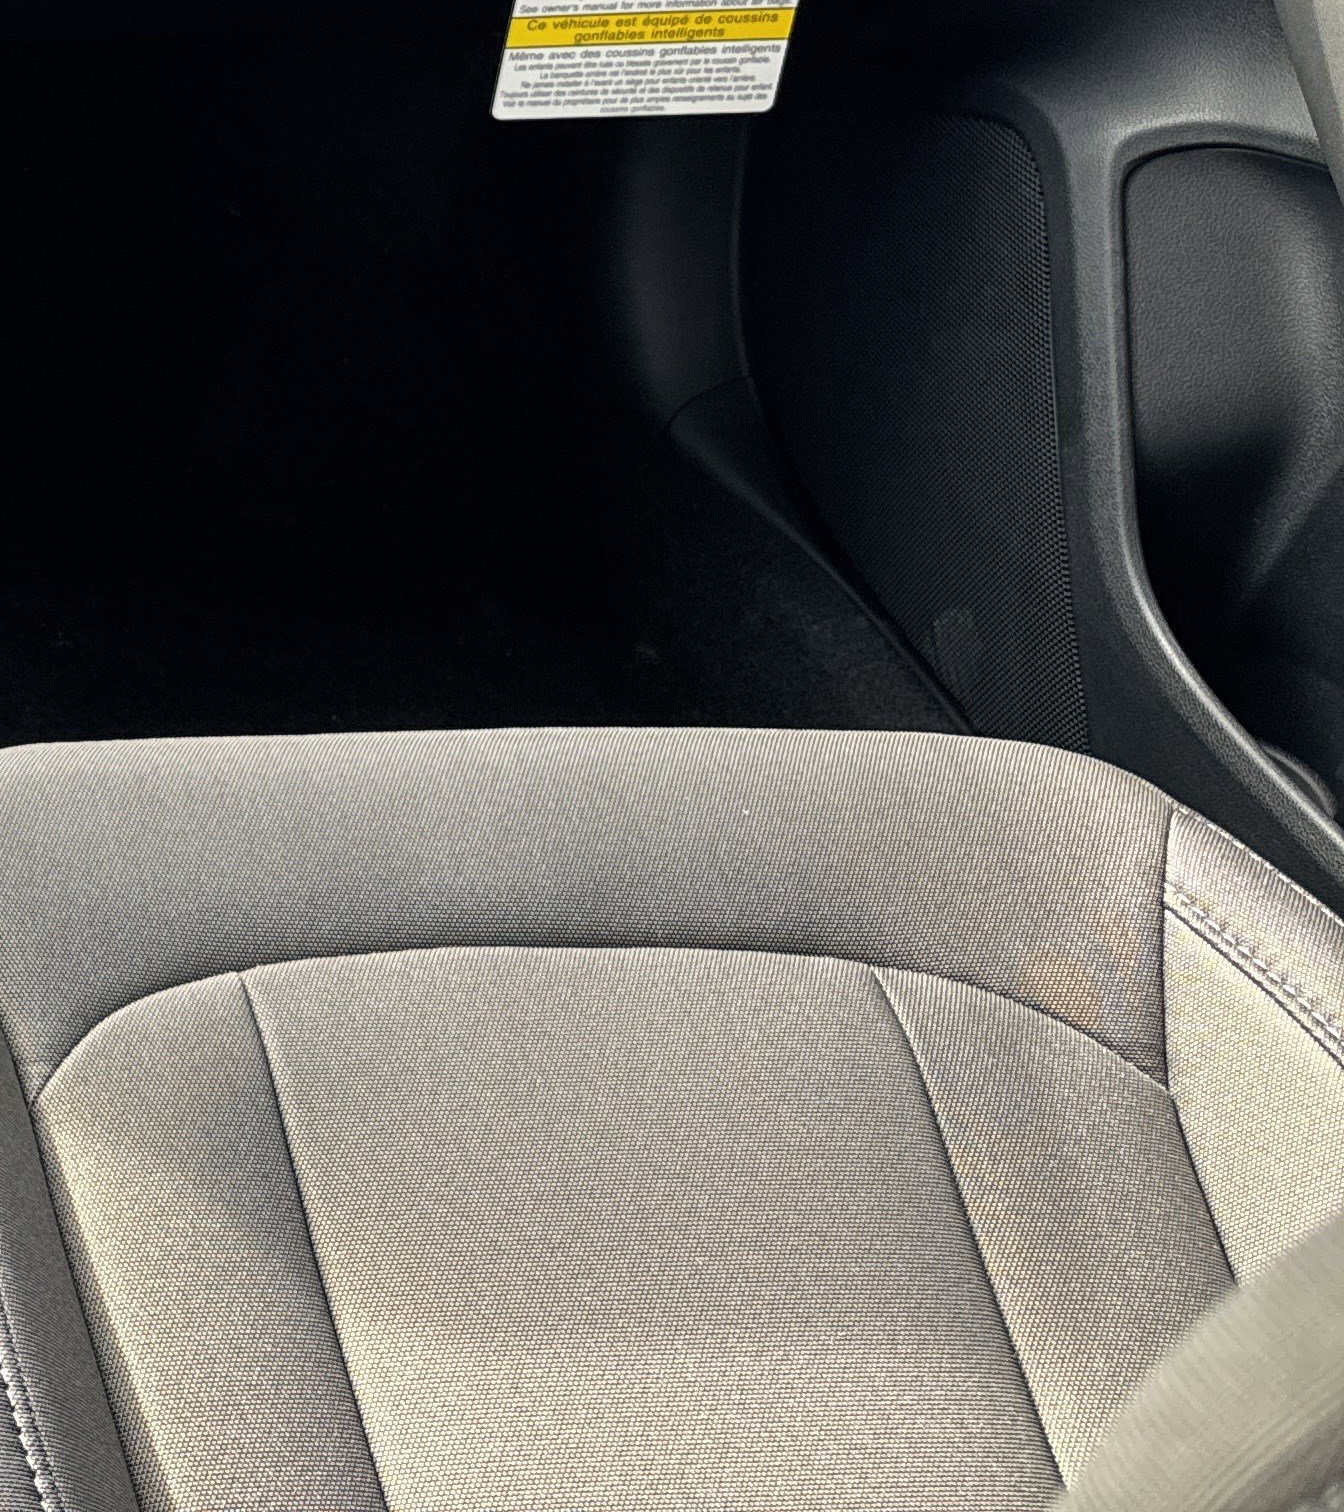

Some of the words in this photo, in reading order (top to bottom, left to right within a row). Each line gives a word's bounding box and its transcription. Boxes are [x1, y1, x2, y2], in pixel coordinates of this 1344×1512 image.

[527, 20, 546, 31] Ce
[615, 17, 637, 27] est
[695, 14, 712, 24] de
[717, 12, 779, 24] coussins
[573, 30, 645, 44] gonflables
[651, 27, 726, 39] intelligents
